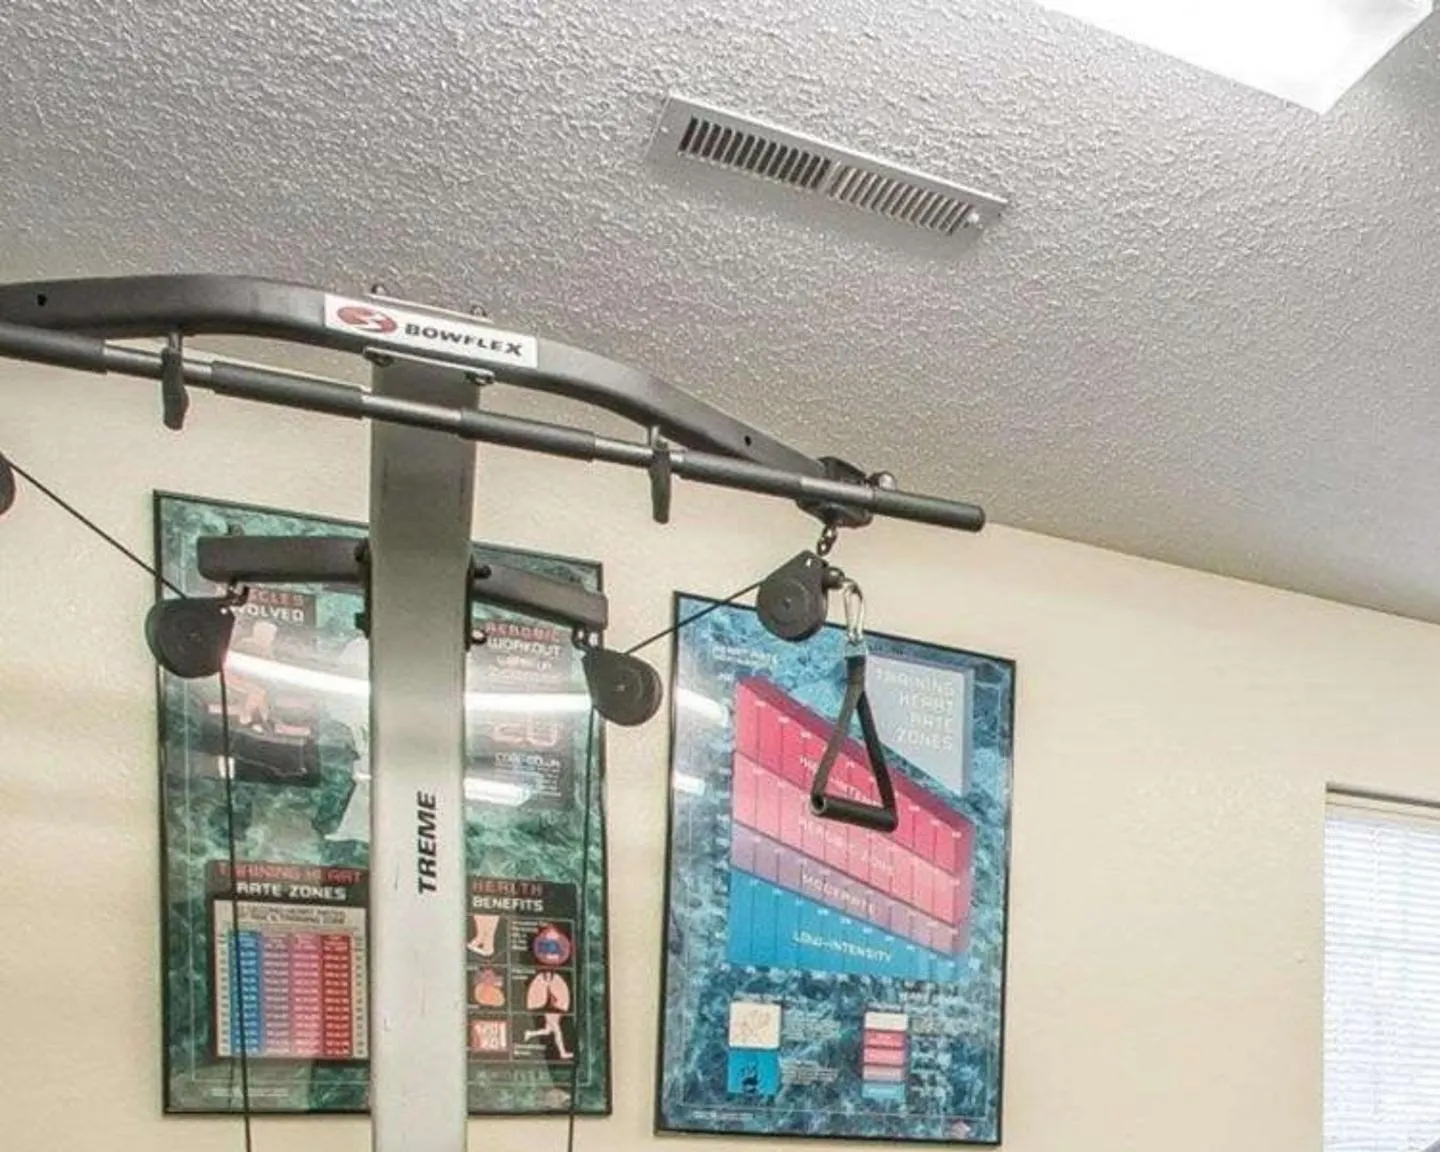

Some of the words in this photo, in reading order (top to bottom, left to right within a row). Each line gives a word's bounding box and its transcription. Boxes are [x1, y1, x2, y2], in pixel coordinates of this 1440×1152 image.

[404, 323, 523, 356] BOWFLEX
[235, 881, 282, 898] RATE
[287, 884, 347, 900] ZONES
[472, 881, 543, 898] HEALTH
[472, 895, 544, 912] BENEFITS
